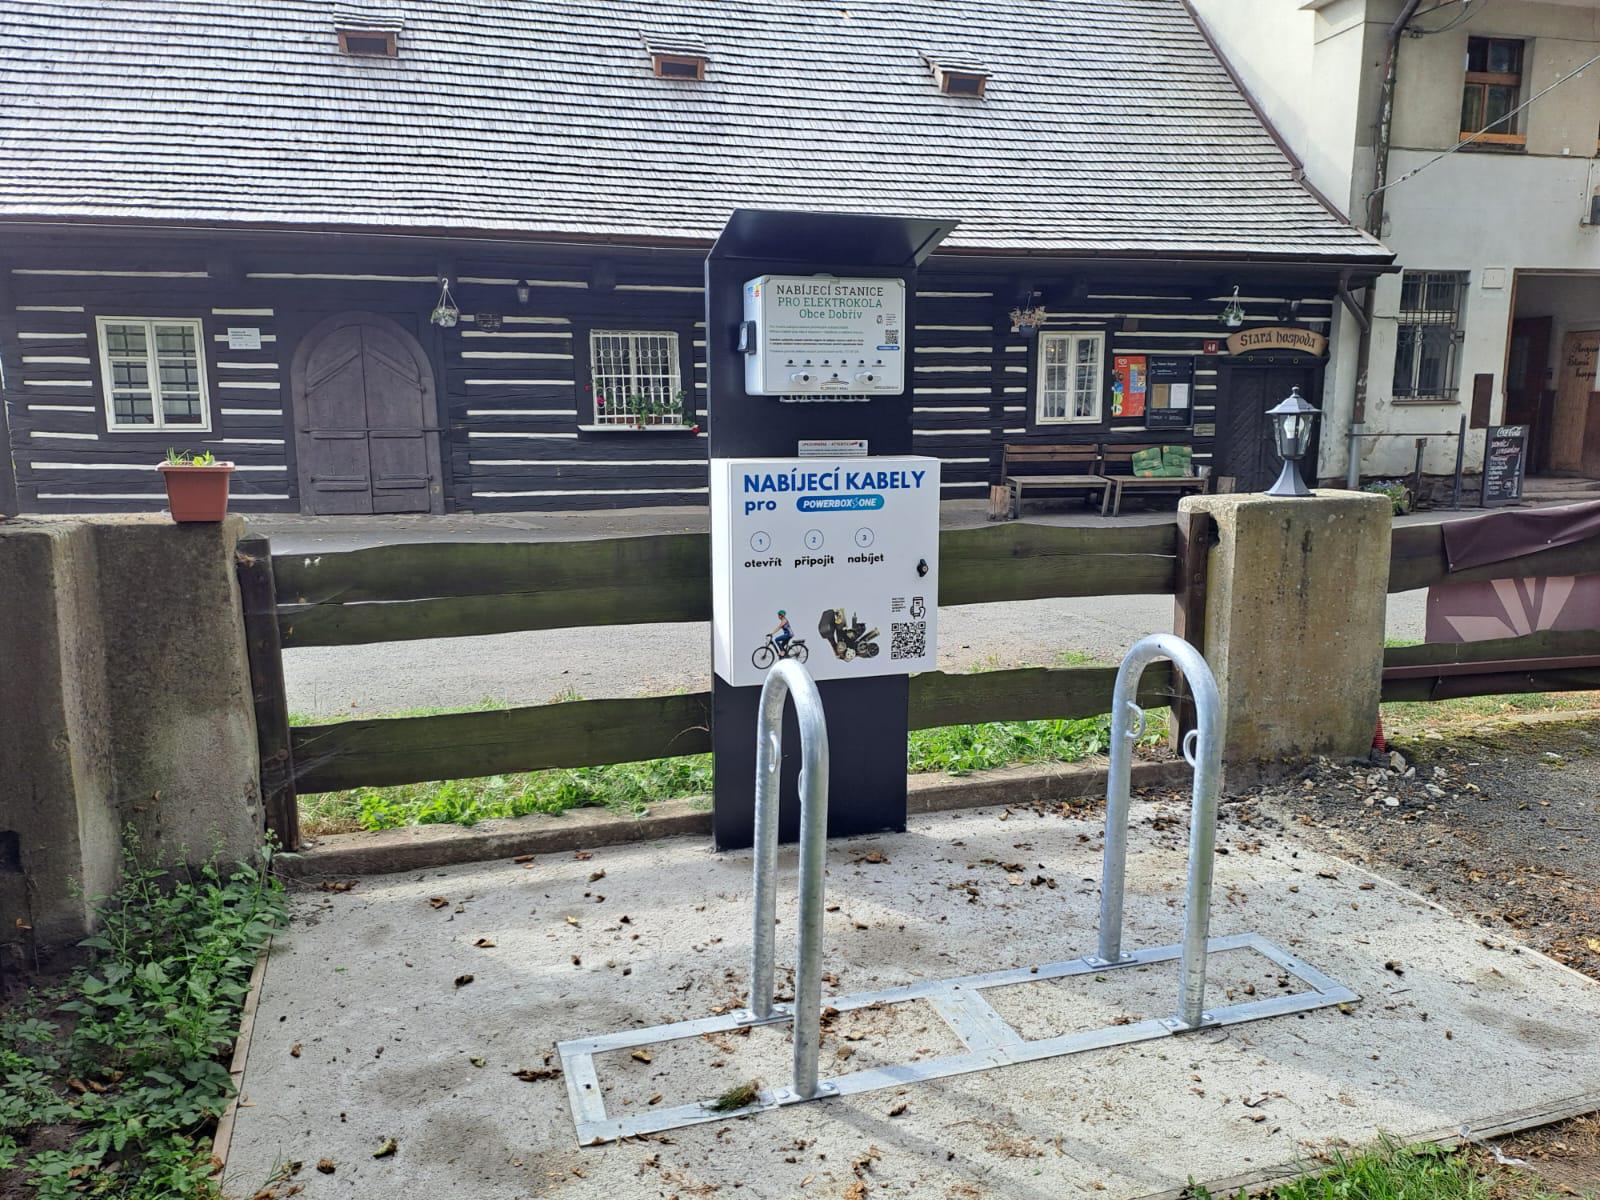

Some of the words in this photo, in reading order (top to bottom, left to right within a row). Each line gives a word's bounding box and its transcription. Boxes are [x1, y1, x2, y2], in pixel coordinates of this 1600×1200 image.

[776, 284, 831, 296] NABÍJECÍ
[834, 286, 884, 297] STANICE
[778, 297, 800, 307] PRO
[803, 297, 883, 308] ELEKTROKOLA
[799, 309, 825, 319] Obce
[1240, 331, 1272, 347] Stará
[1276, 331, 1315, 348] hospoda
[744, 467, 840, 493] NABÍJECÍ
[846, 470, 926, 490] KABELY
[745, 500, 777, 515] pro
[803, 499, 854, 509] POWERBOX
[858, 498, 878, 507] ONE
[744, 556, 783, 568] otevřít
